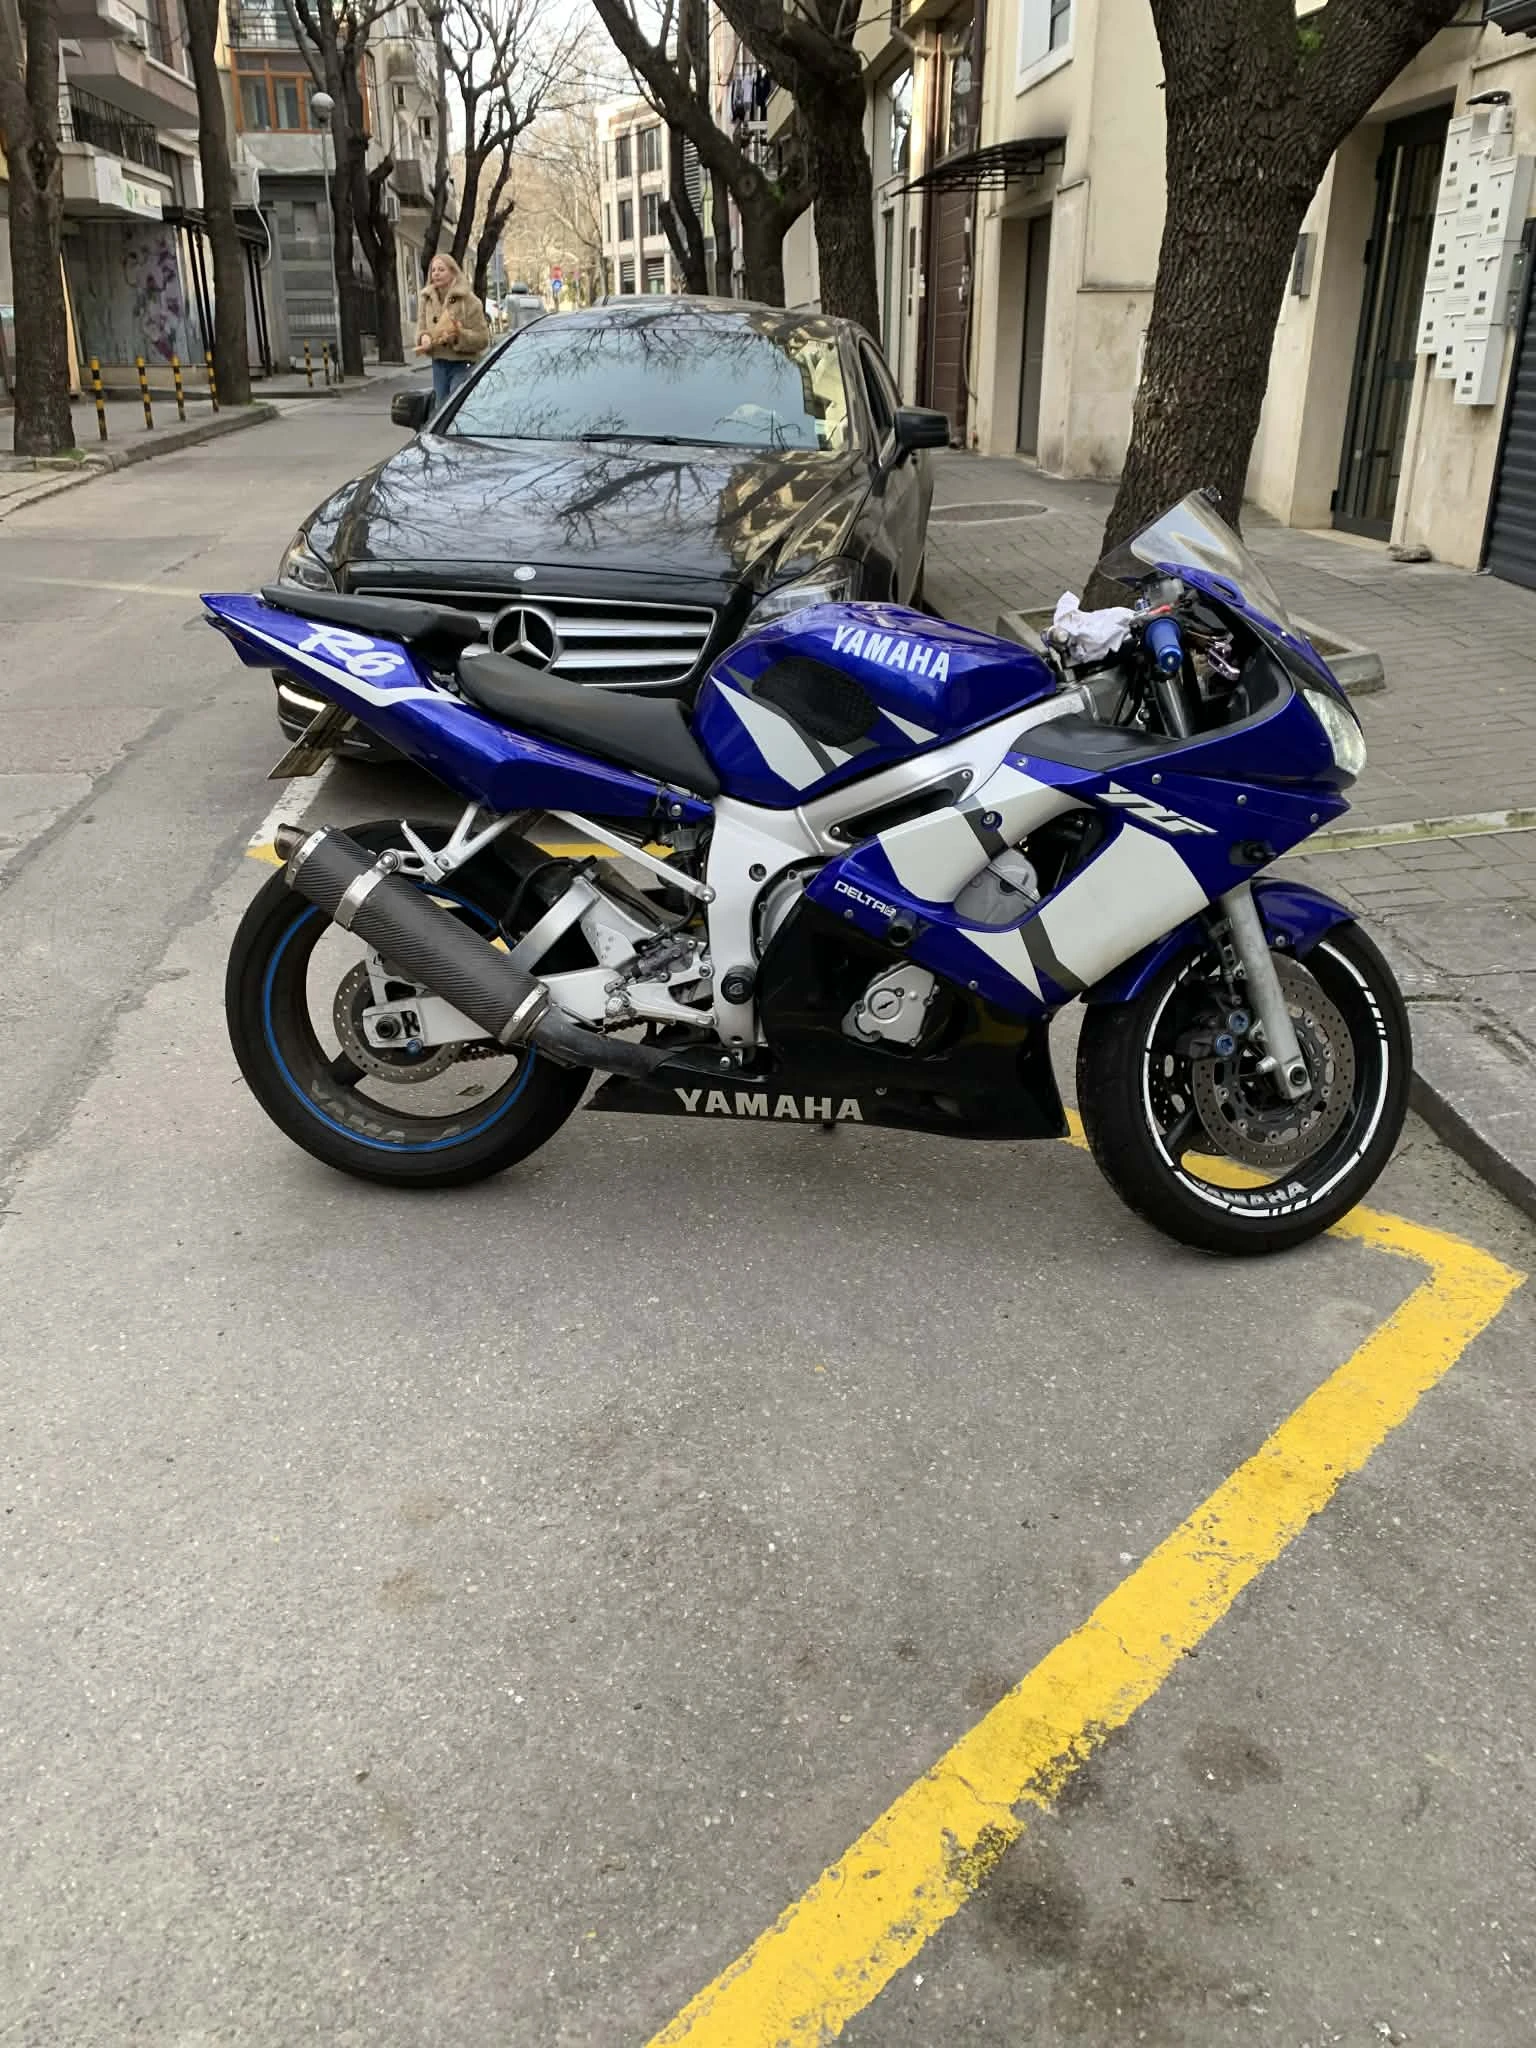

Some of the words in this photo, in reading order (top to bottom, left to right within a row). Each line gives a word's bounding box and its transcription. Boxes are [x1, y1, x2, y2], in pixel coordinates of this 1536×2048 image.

[298, 622, 405, 677] R6
[831, 624, 950, 683] YAMAHA
[674, 1087, 864, 1121] YAMAHA
